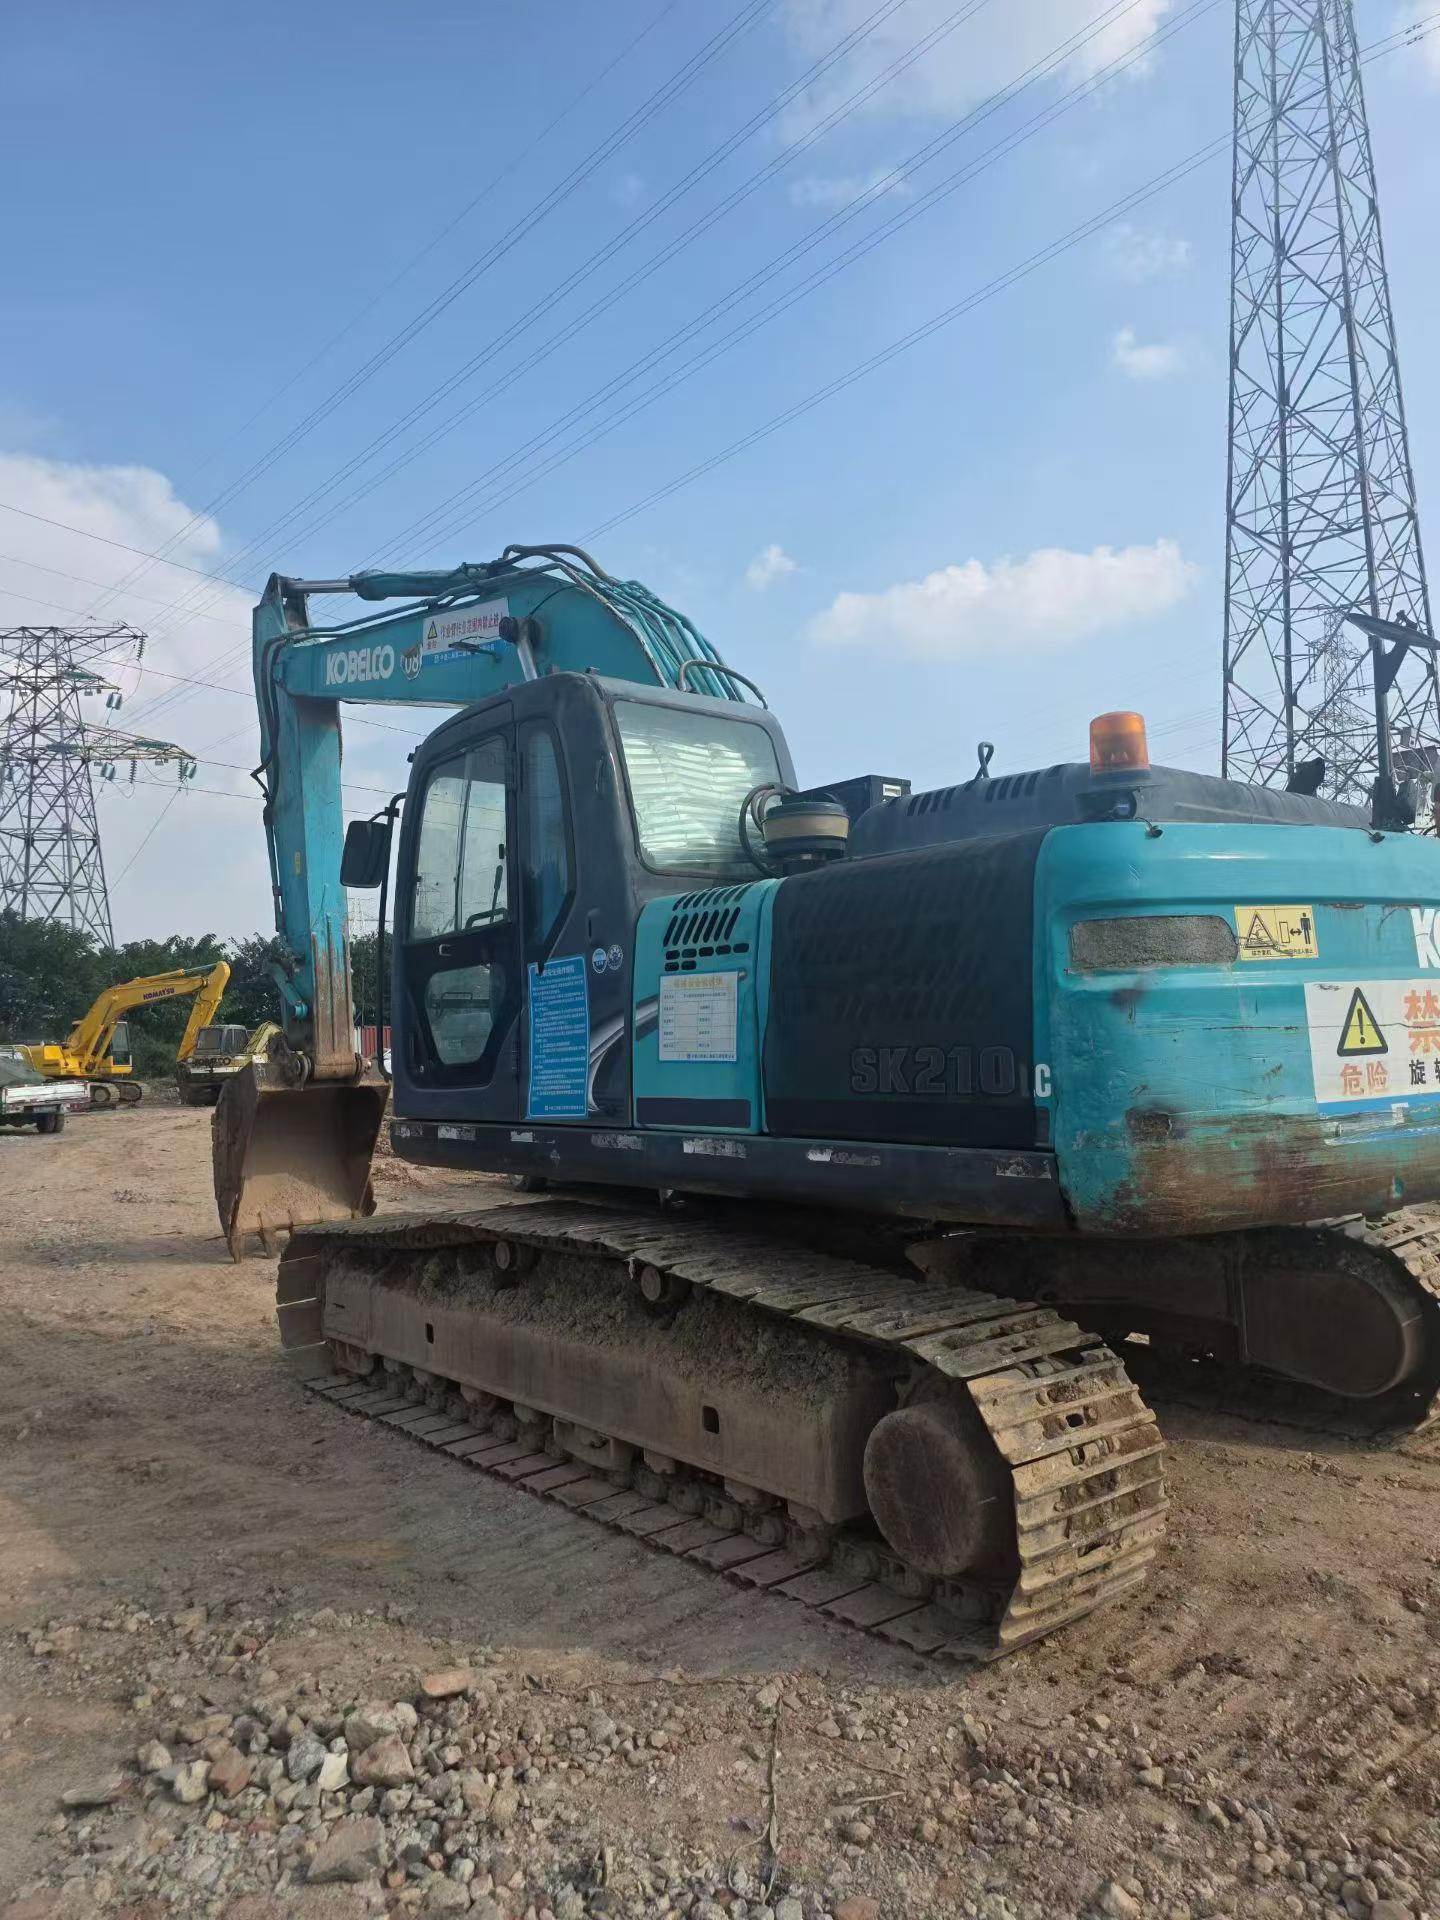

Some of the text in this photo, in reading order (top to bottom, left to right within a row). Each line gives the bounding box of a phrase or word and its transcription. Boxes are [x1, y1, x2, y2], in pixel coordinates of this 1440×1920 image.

[326, 645, 394, 685] KOBELCO
[1410, 908, 1440, 969] K
[143, 986, 175, 1000] KOMATSU
[851, 1044, 1016, 1095] SK210
[1340, 1060, 1389, 1095] 危险
